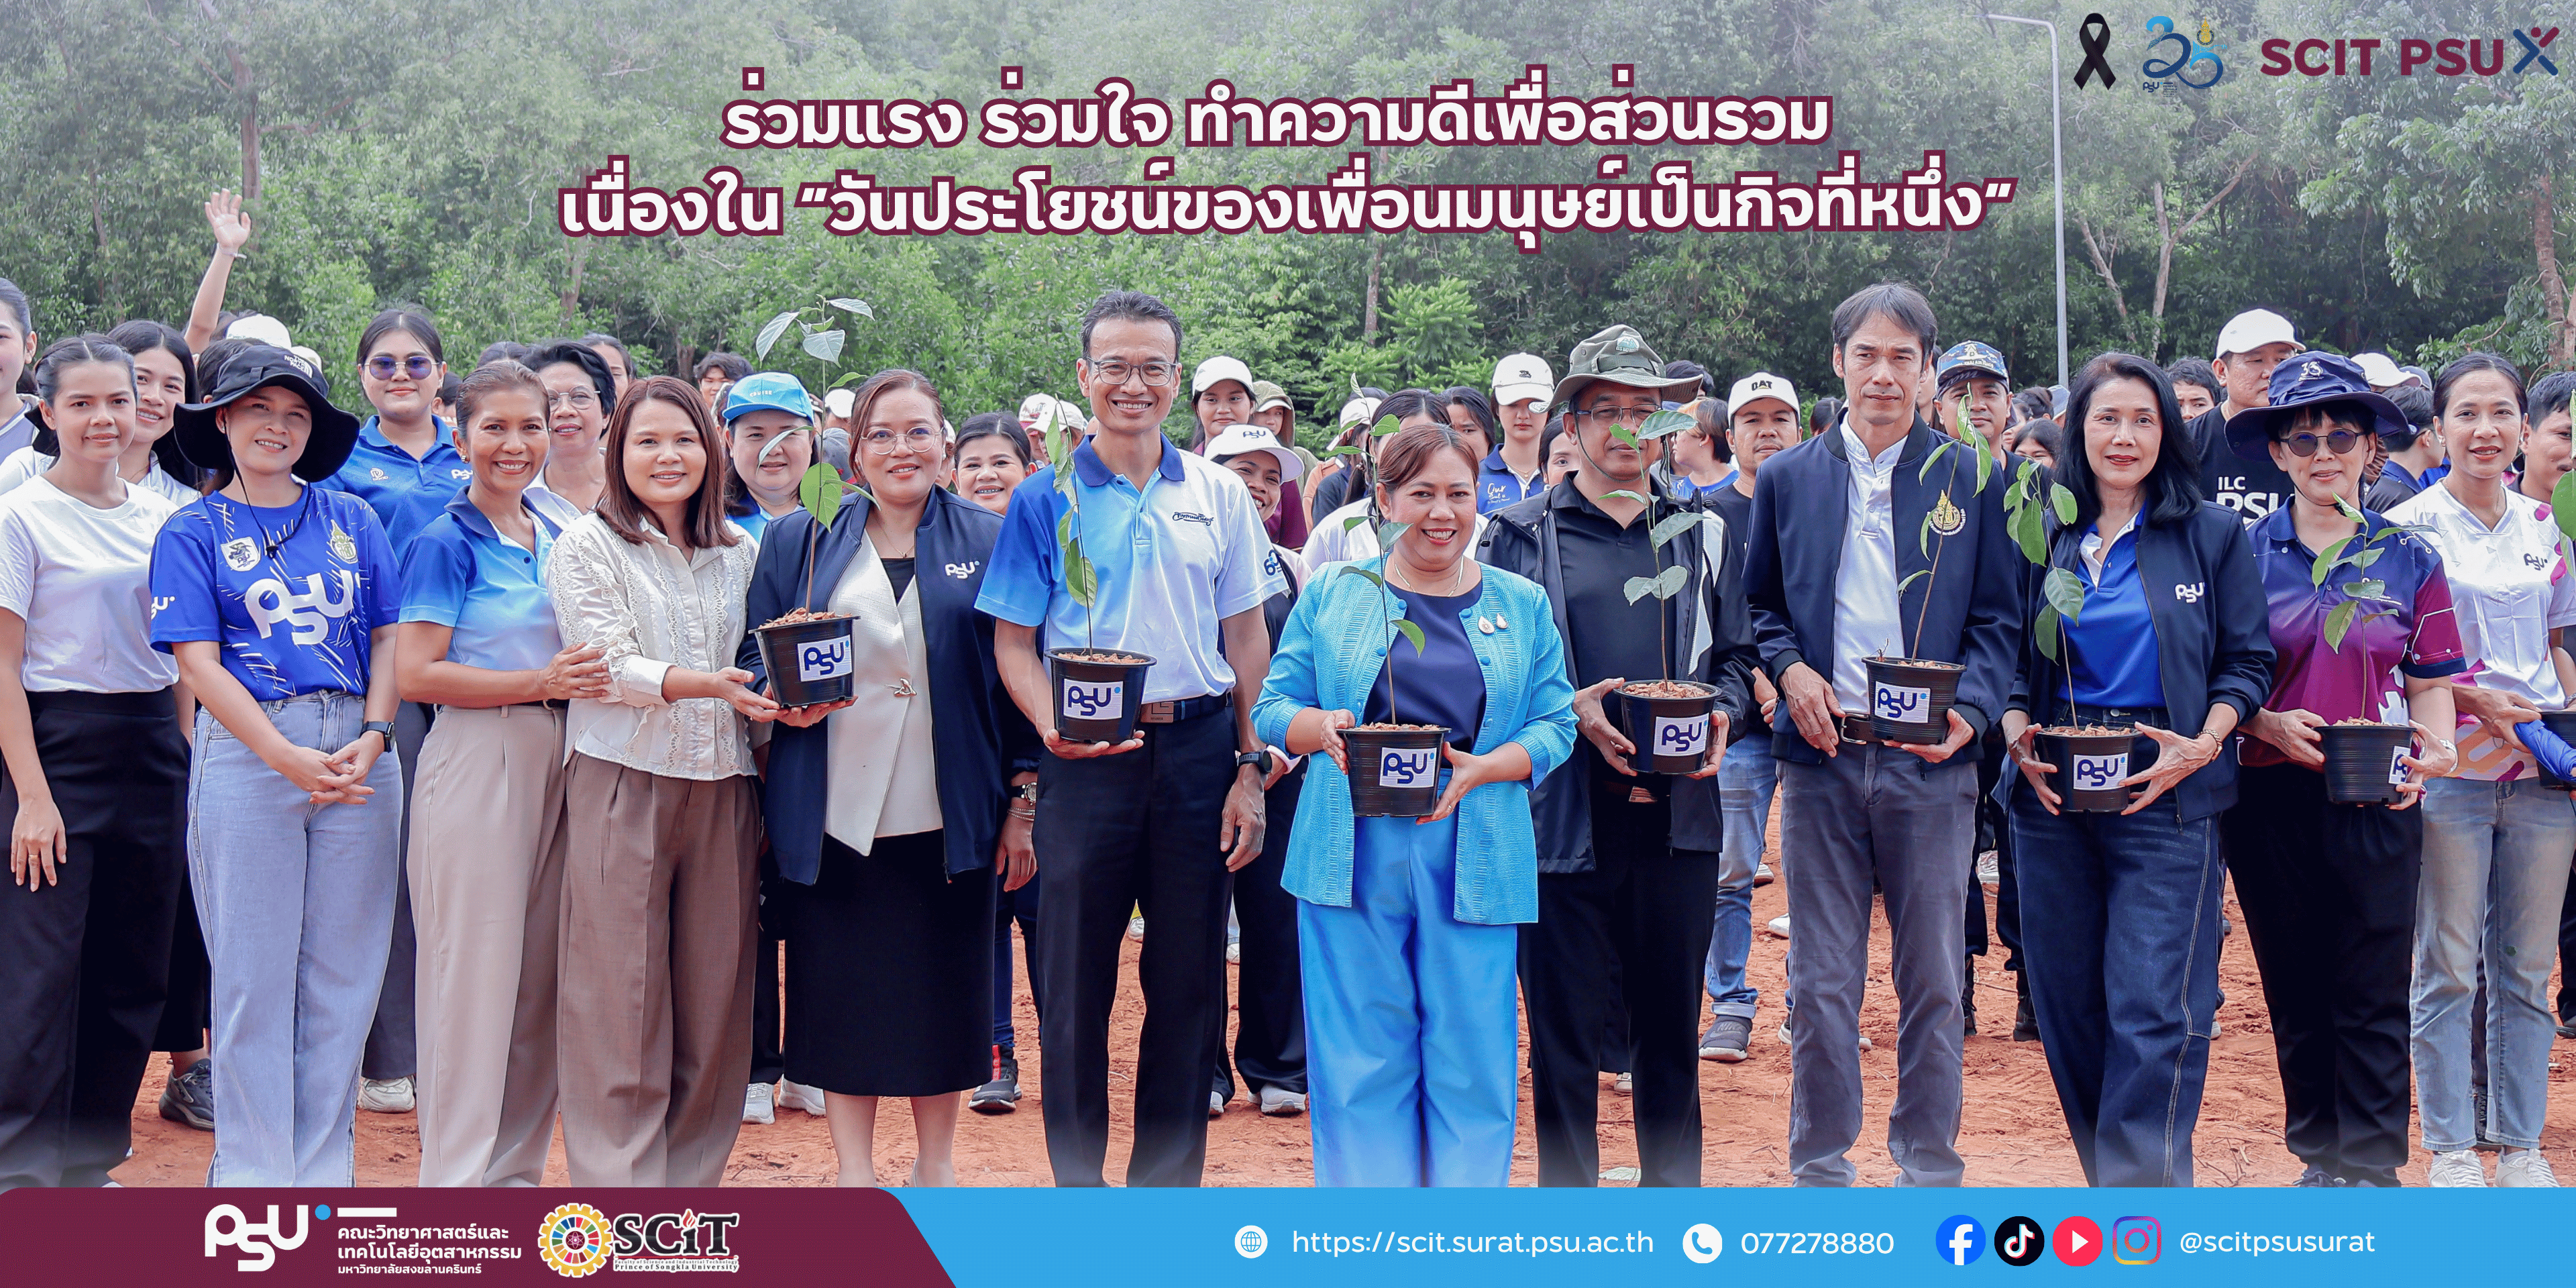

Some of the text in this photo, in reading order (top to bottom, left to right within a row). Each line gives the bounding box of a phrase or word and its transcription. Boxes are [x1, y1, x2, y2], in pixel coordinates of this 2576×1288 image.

[1243, 430, 1266, 439] PSU
[2218, 476, 2246, 490] ILC
[945, 561, 976, 579] PSU
[2524, 553, 2544, 571] PSU
[246, 569, 354, 645] PSU
[2175, 582, 2204, 603] PSU
[804, 641, 845, 676] PSU
[1068, 686, 1112, 716] PSU
[1877, 688, 1917, 718] PSU
[1661, 721, 1702, 752] PSU
[1383, 753, 1428, 784] PSU
[2077, 757, 2118, 787] PSU
